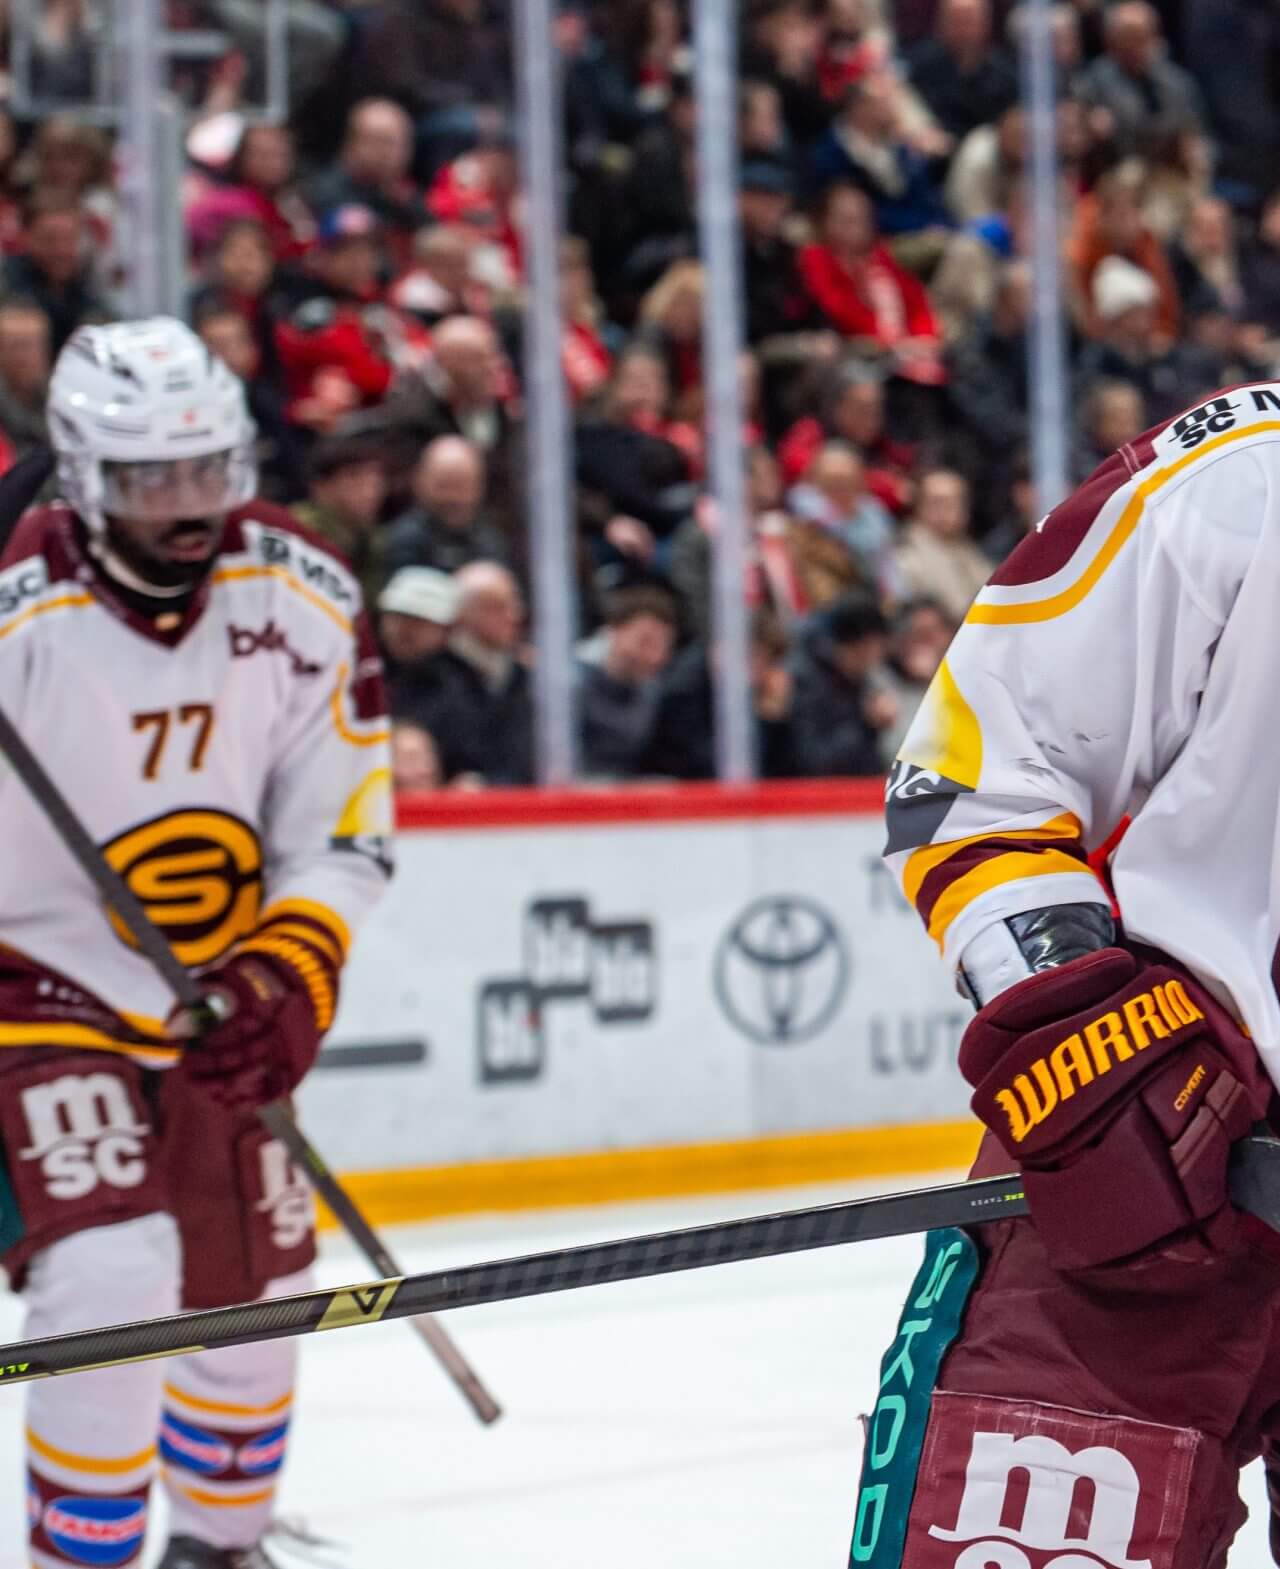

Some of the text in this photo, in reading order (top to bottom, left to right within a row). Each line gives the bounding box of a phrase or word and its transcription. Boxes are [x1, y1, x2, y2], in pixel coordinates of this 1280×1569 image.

[132, 704, 215, 780] 77
[993, 979, 1205, 1143] WARRIO
[852, 1241, 963, 1563] SKOD
